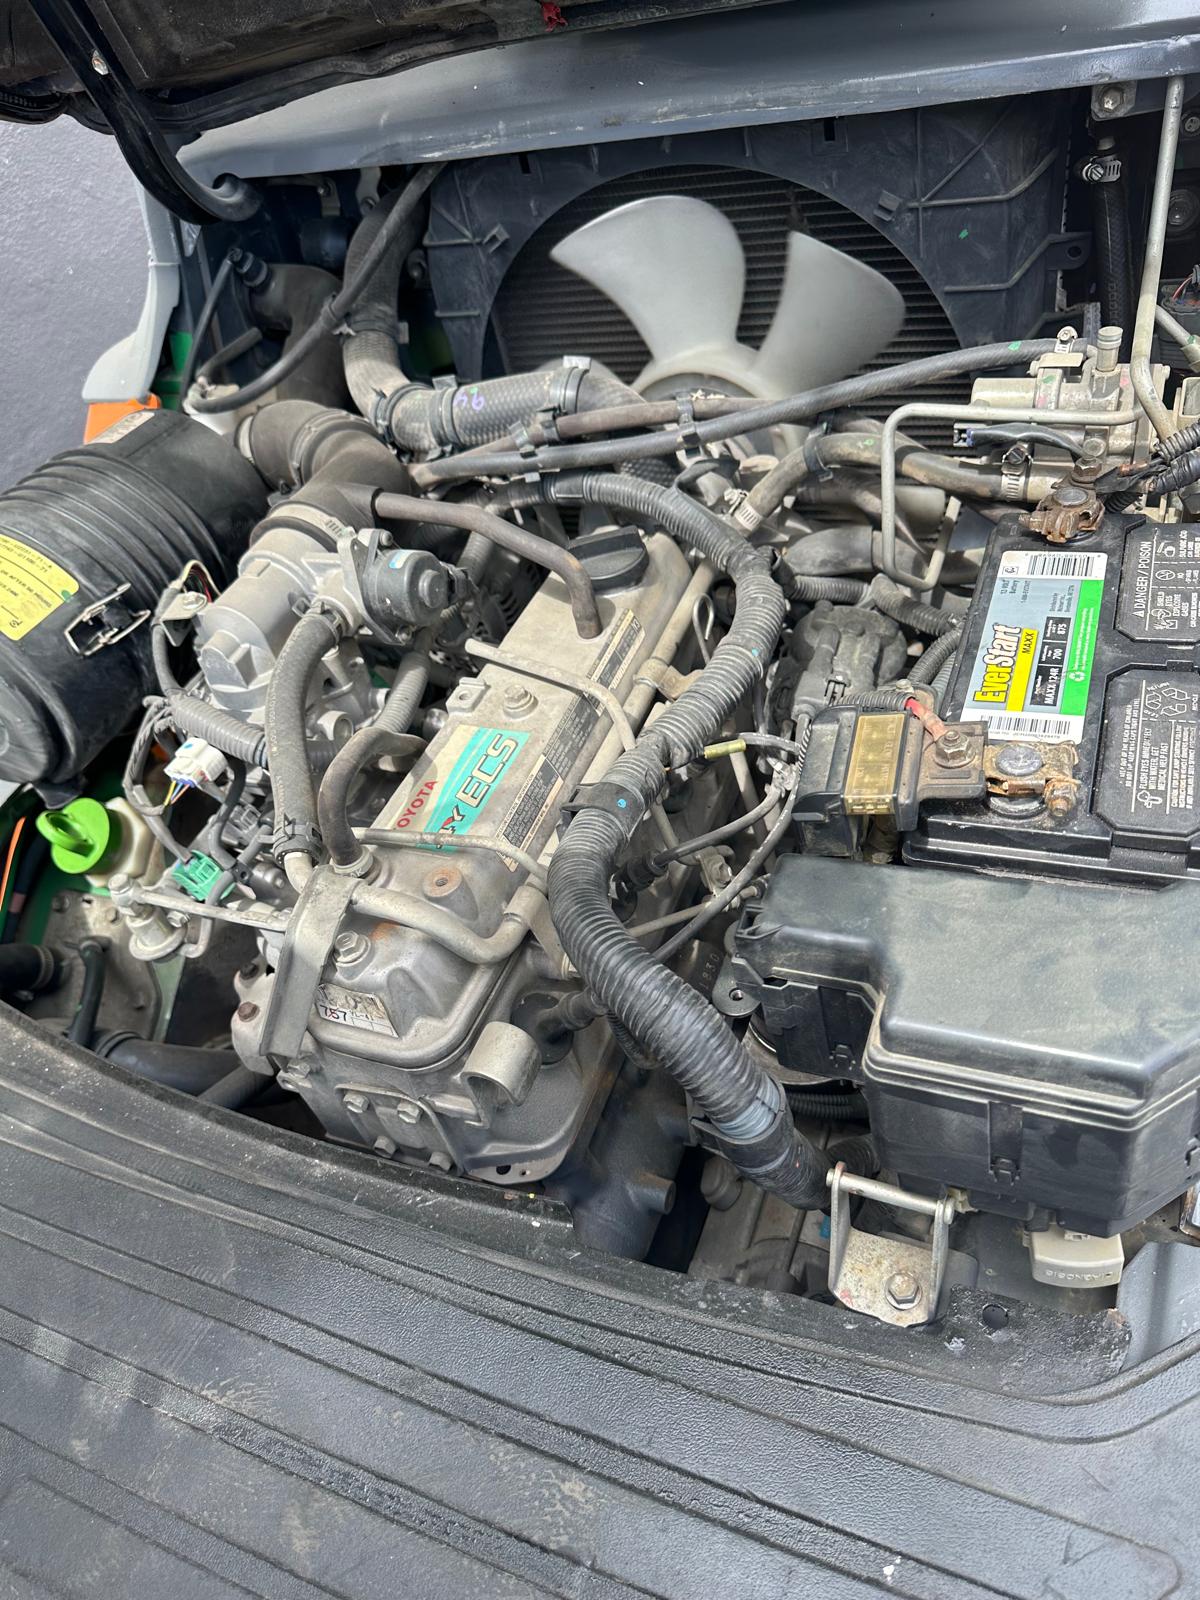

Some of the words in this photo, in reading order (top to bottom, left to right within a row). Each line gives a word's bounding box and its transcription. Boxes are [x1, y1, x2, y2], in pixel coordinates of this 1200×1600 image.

[1138, 541, 1151, 568] POISON
[1134, 575, 1148, 608] DANGER
[1057, 622, 1067, 635] 875
[1021, 631, 1034, 654] MAXX
[973, 622, 1021, 703] EverStart
[1052, 647, 1062, 660] 700
[1048, 666, 1059, 683] 124R
[1044, 683, 1056, 704] MAXX
[1151, 745, 1159, 756] GET
[1159, 742, 1168, 754] FAST
[1140, 758, 1149, 772] EYES
[1158, 753, 1167, 767] HELP
[456, 733, 519, 809] ECS
[1138, 771, 1147, 789] FLUSH
[1156, 767, 1166, 790] MEDICAL
[1147, 775, 1156, 790] WITH
[395, 780, 439, 831] OYOTA
[495, 818, 509, 838] MISSION
[516, 772, 536, 801] INFORMATION
